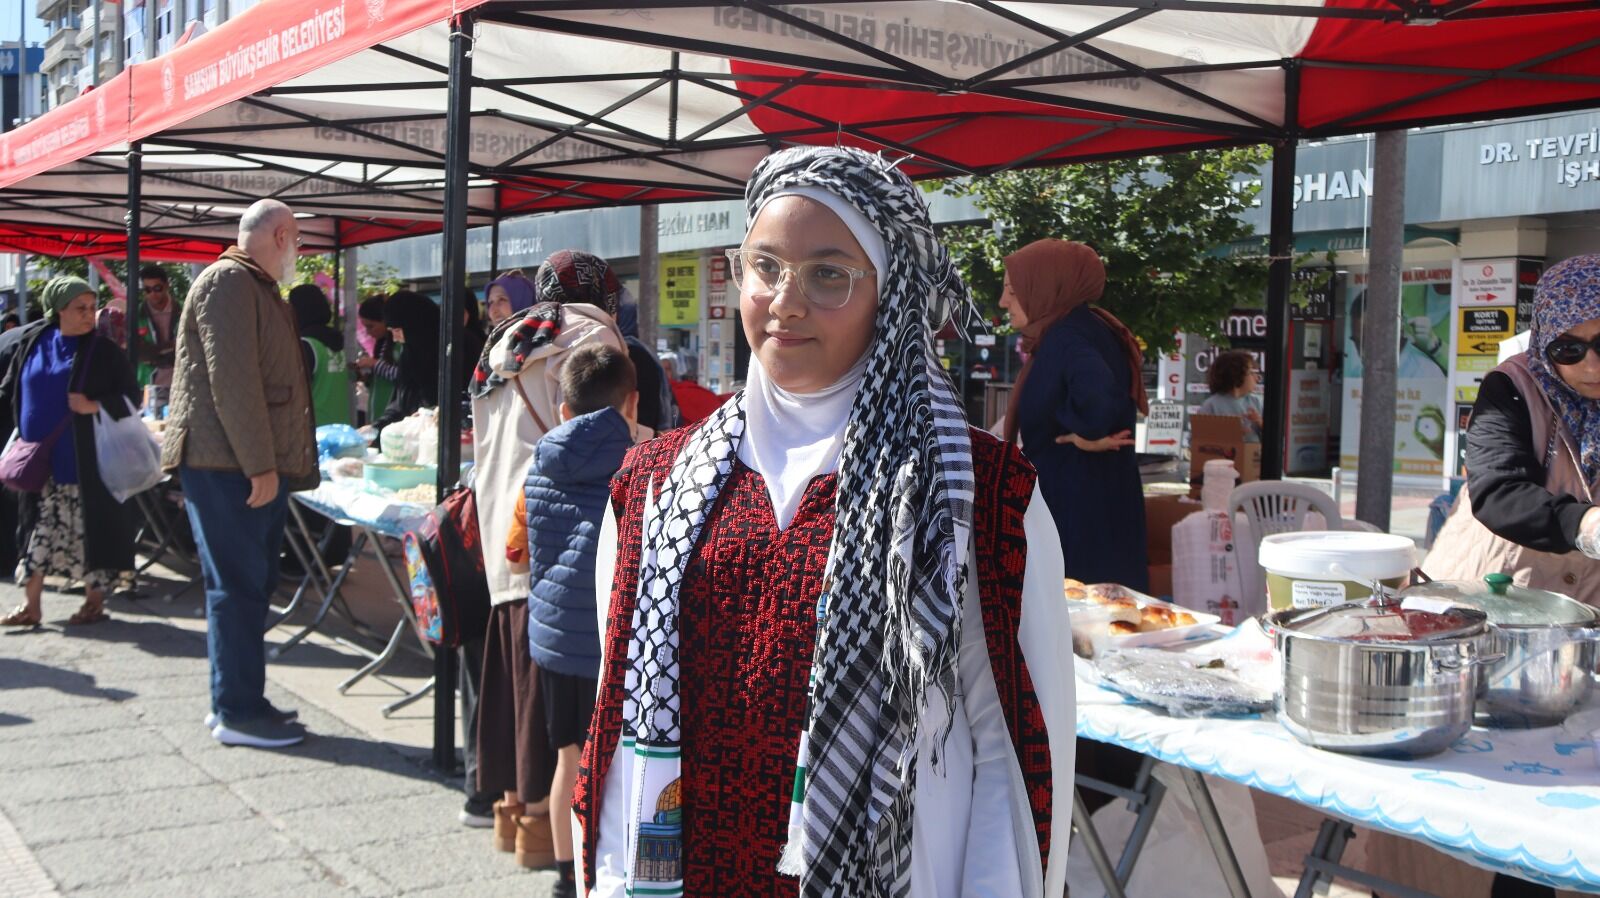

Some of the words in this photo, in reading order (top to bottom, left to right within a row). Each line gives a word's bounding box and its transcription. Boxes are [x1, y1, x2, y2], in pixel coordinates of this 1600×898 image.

[183, 62, 218, 100] SAMSUN
[219, 29, 281, 86] BÜYÜKŞEHİR
[281, 3, 346, 59] BELEDİYESİ
[1480, 142, 1519, 165] DR.
[1526, 127, 1600, 160] TEVFİ
[1294, 168, 1374, 209] ŞHAN
[1557, 159, 1600, 188] İŞH
[1151, 411, 1181, 420] İŞİTME
